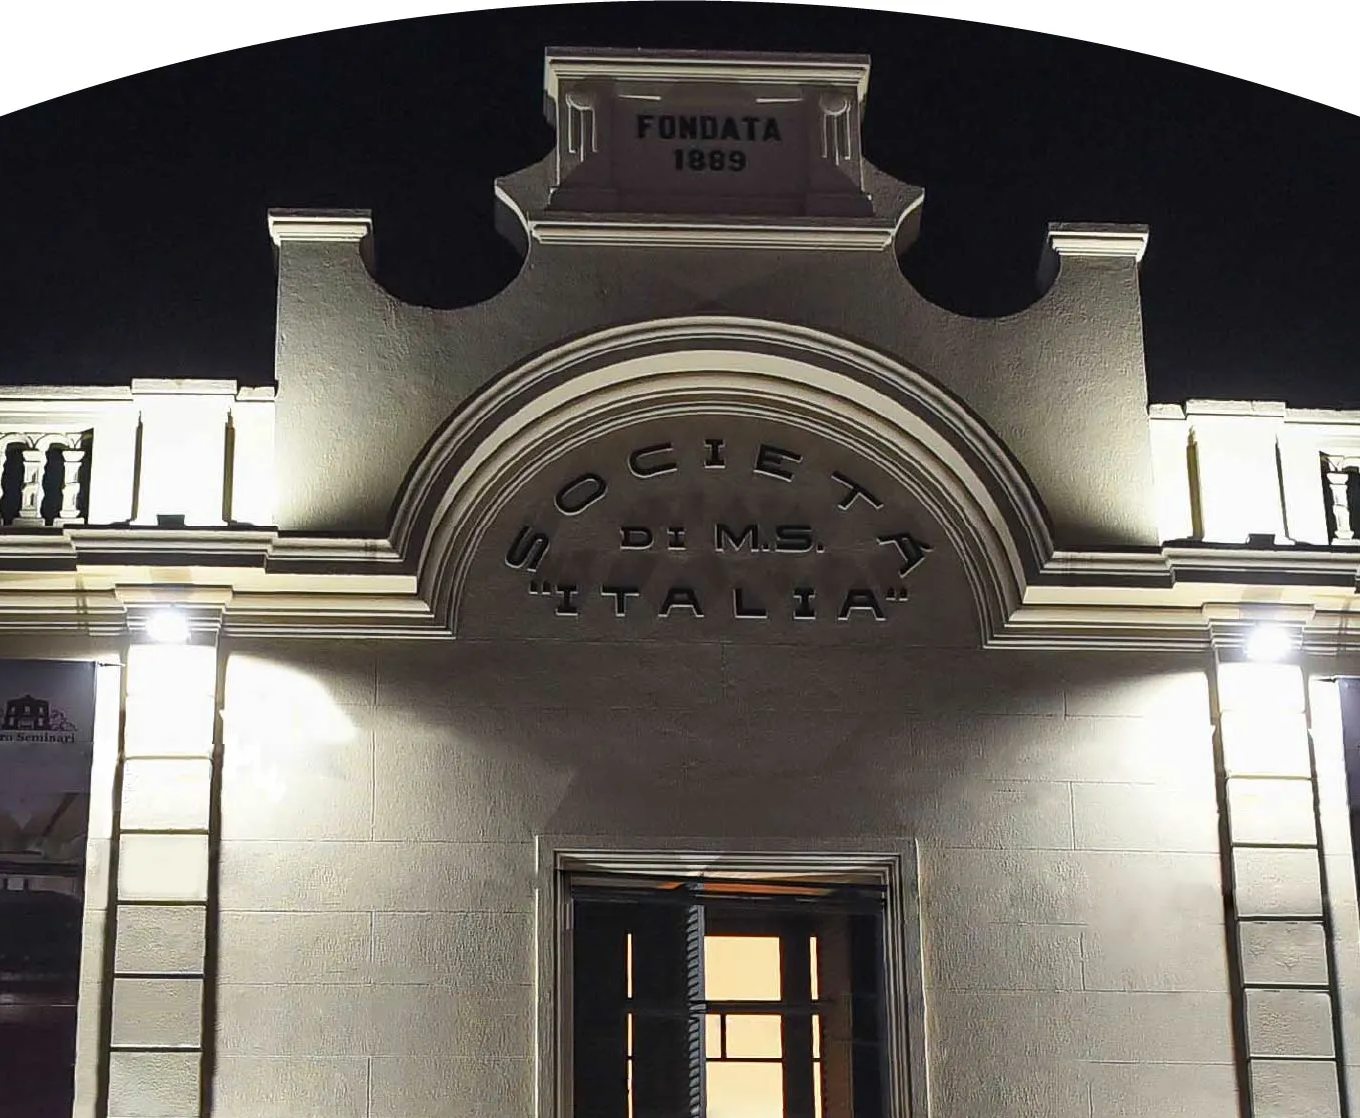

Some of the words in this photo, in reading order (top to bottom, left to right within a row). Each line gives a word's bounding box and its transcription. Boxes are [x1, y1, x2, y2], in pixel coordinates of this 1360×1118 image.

[635, 114, 782, 141] FONDATA
[674, 149, 746, 172] 1889
[619, 526, 687, 551] DI
[714, 523, 825, 553] M.S.
